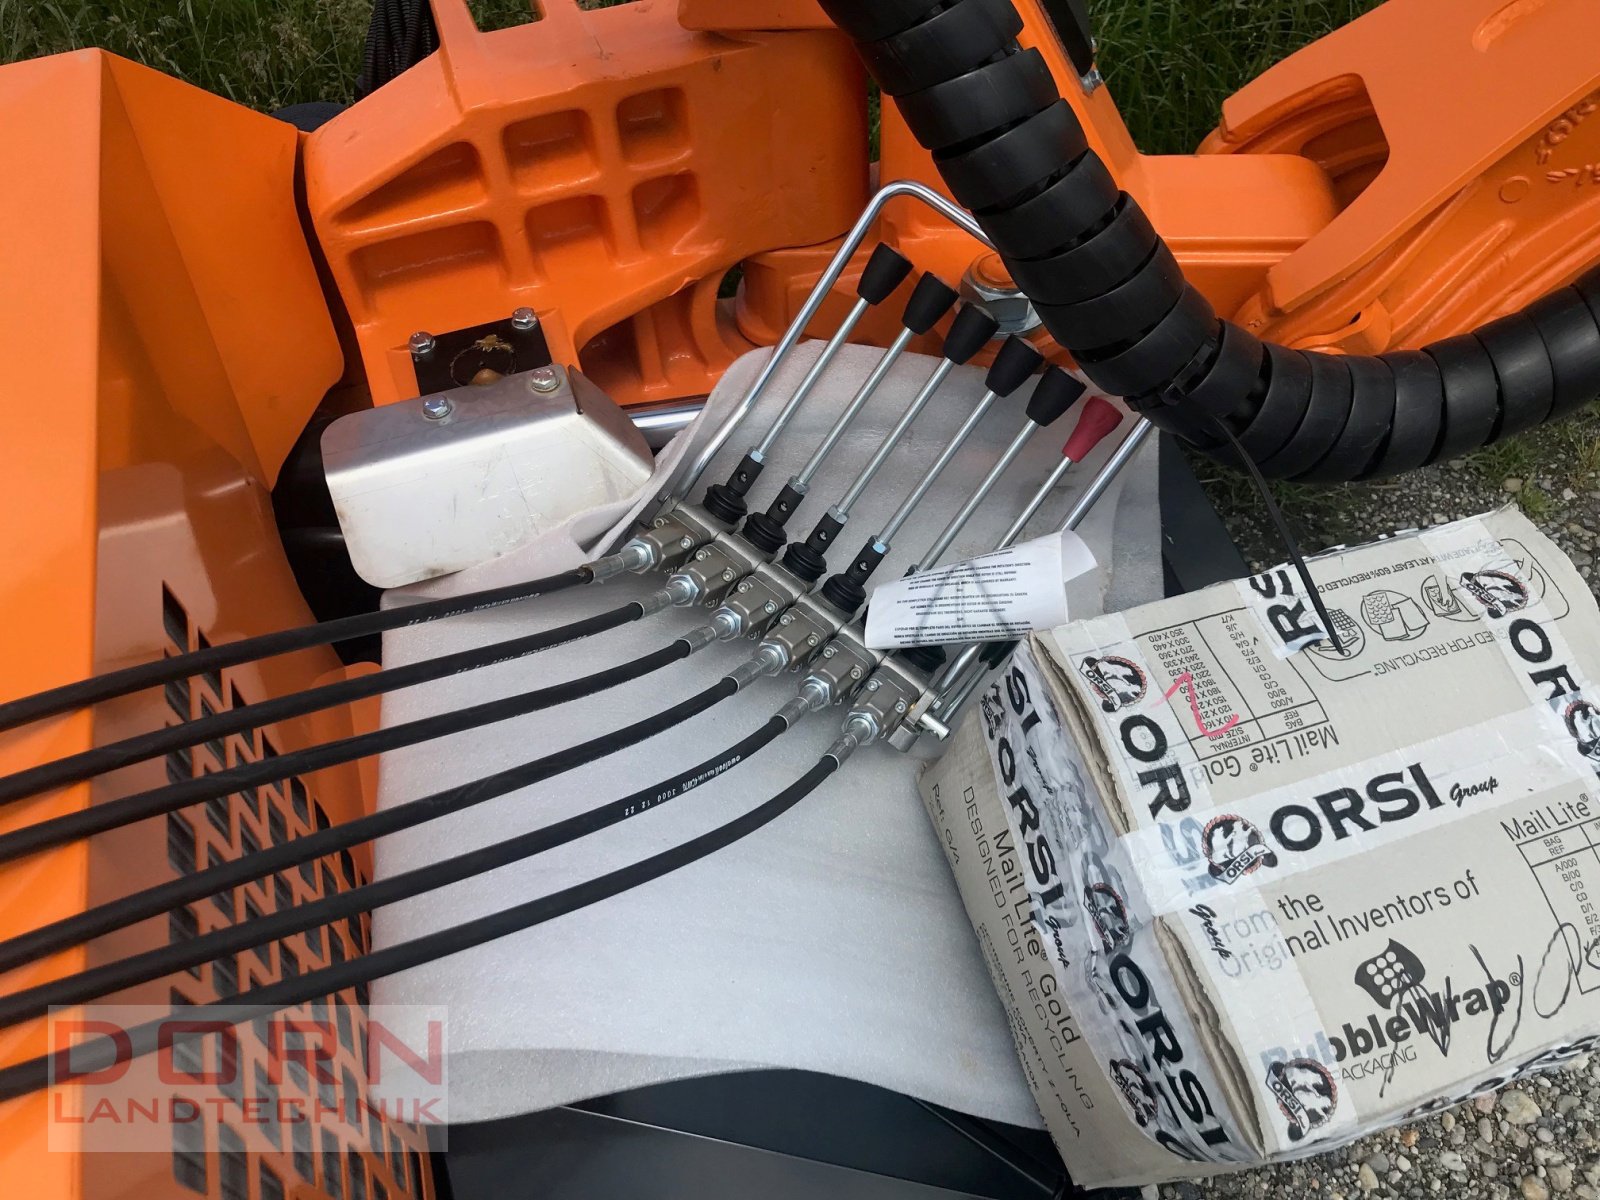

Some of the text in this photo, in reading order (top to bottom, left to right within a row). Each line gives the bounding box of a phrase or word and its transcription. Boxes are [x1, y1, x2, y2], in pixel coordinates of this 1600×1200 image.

[1392, 560, 1418, 572] LEAST
[1419, 557, 1429, 565] AT
[1370, 567, 1390, 578] 60%
[1325, 572, 1371, 590] RECYCLED
[1226, 623, 1237, 632] J/6
[1148, 628, 1184, 642] 350 X 470
[1230, 631, 1244, 640] H/5
[1153, 637, 1189, 651] 300 X 440
[1180, 645, 1194, 654] 270
[1236, 640, 1249, 648] G/4
[1449, 636, 1475, 652] FOR
[1158, 651, 1173, 660] 360
[1185, 653, 1199, 663] 240
[1164, 659, 1178, 668] 330
[1190, 662, 1205, 671] 220
[1168, 668, 1183, 676] 330
[1196, 670, 1210, 679] 220
[1085, 669, 1114, 696] ORSI
[1202, 678, 1216, 687] 180
[1199, 690, 1207, 698] X
[1207, 687, 1221, 696] 180
[1268, 688, 1286, 699] B/00
[1212, 696, 1227, 706] 150
[1271, 697, 1293, 708] A/000
[1218, 704, 1232, 714] 120
[1284, 710, 1299, 720] REF
[1216, 718, 1224, 726] X
[1285, 718, 1303, 729] BAG
[1207, 727, 1244, 743] SIZE mm
[1294, 725, 1339, 756] Mail
[1210, 734, 1250, 752] INTERNAL
[1269, 762, 1499, 851] ORSI Group
[998, 737, 1066, 909] ORSI
[1500, 809, 1551, 842] Mail
[1543, 836, 1562, 848] BAG
[1549, 845, 1565, 856] REF
[1226, 851, 1256, 879] ORSI
[1555, 858, 1578, 872] A/000
[1562, 869, 1581, 882] B/00
[1576, 892, 1588, 902] CD
[1278, 892, 1324, 921] the
[1581, 903, 1594, 914] D/1
[1217, 869, 1480, 978] Original Inventors of
[1585, 914, 1599, 925] E/2
[1189, 902, 1231, 960] Group
[994, 829, 1027, 897] Mail
[1039, 973, 1081, 1045] Gold
[1048, 915, 1070, 969] Group
[963, 786, 1008, 911] DESIGNED
[1001, 911, 1025, 966] FOR
[1021, 969, 1095, 1111] RECYCLING
[1109, 952, 1230, 1147] ORSI
[1272, 1081, 1301, 1115] ORSI
